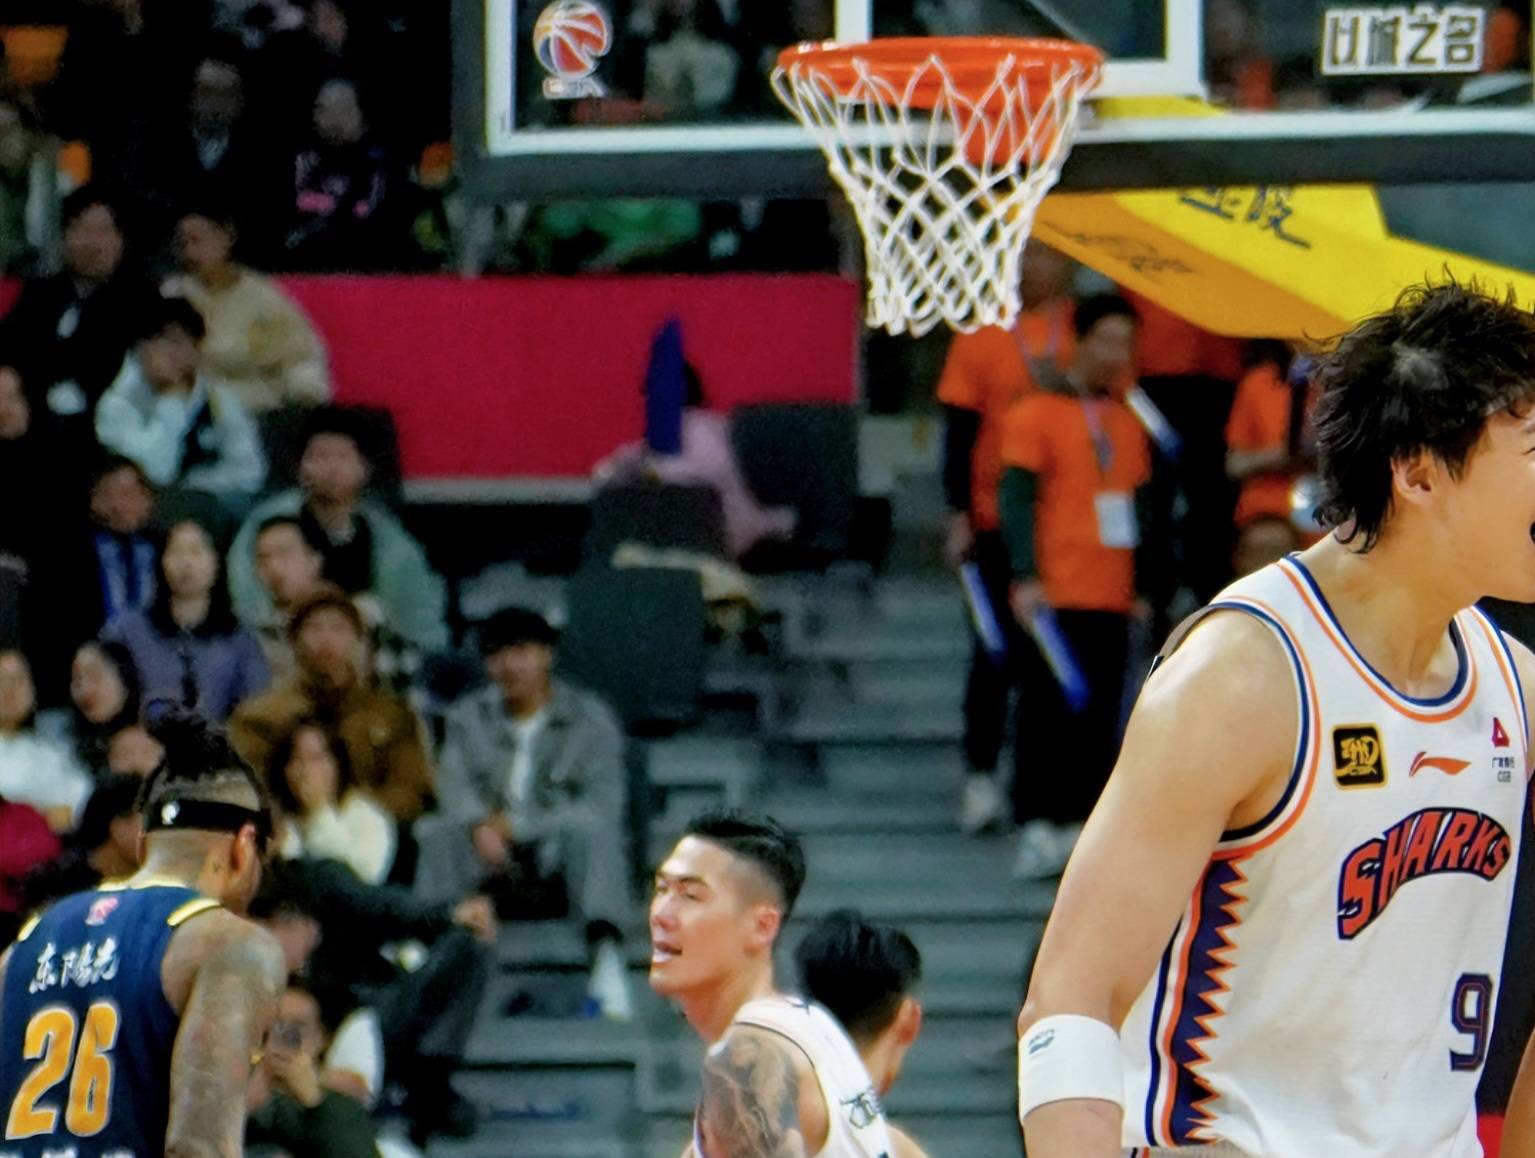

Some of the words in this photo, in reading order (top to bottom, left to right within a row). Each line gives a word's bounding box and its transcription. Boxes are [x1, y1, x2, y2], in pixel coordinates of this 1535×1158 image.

[1338, 807, 1511, 940] SHARKS
[5, 1002, 119, 1141] 26
[1449, 972, 1493, 1072] 9
